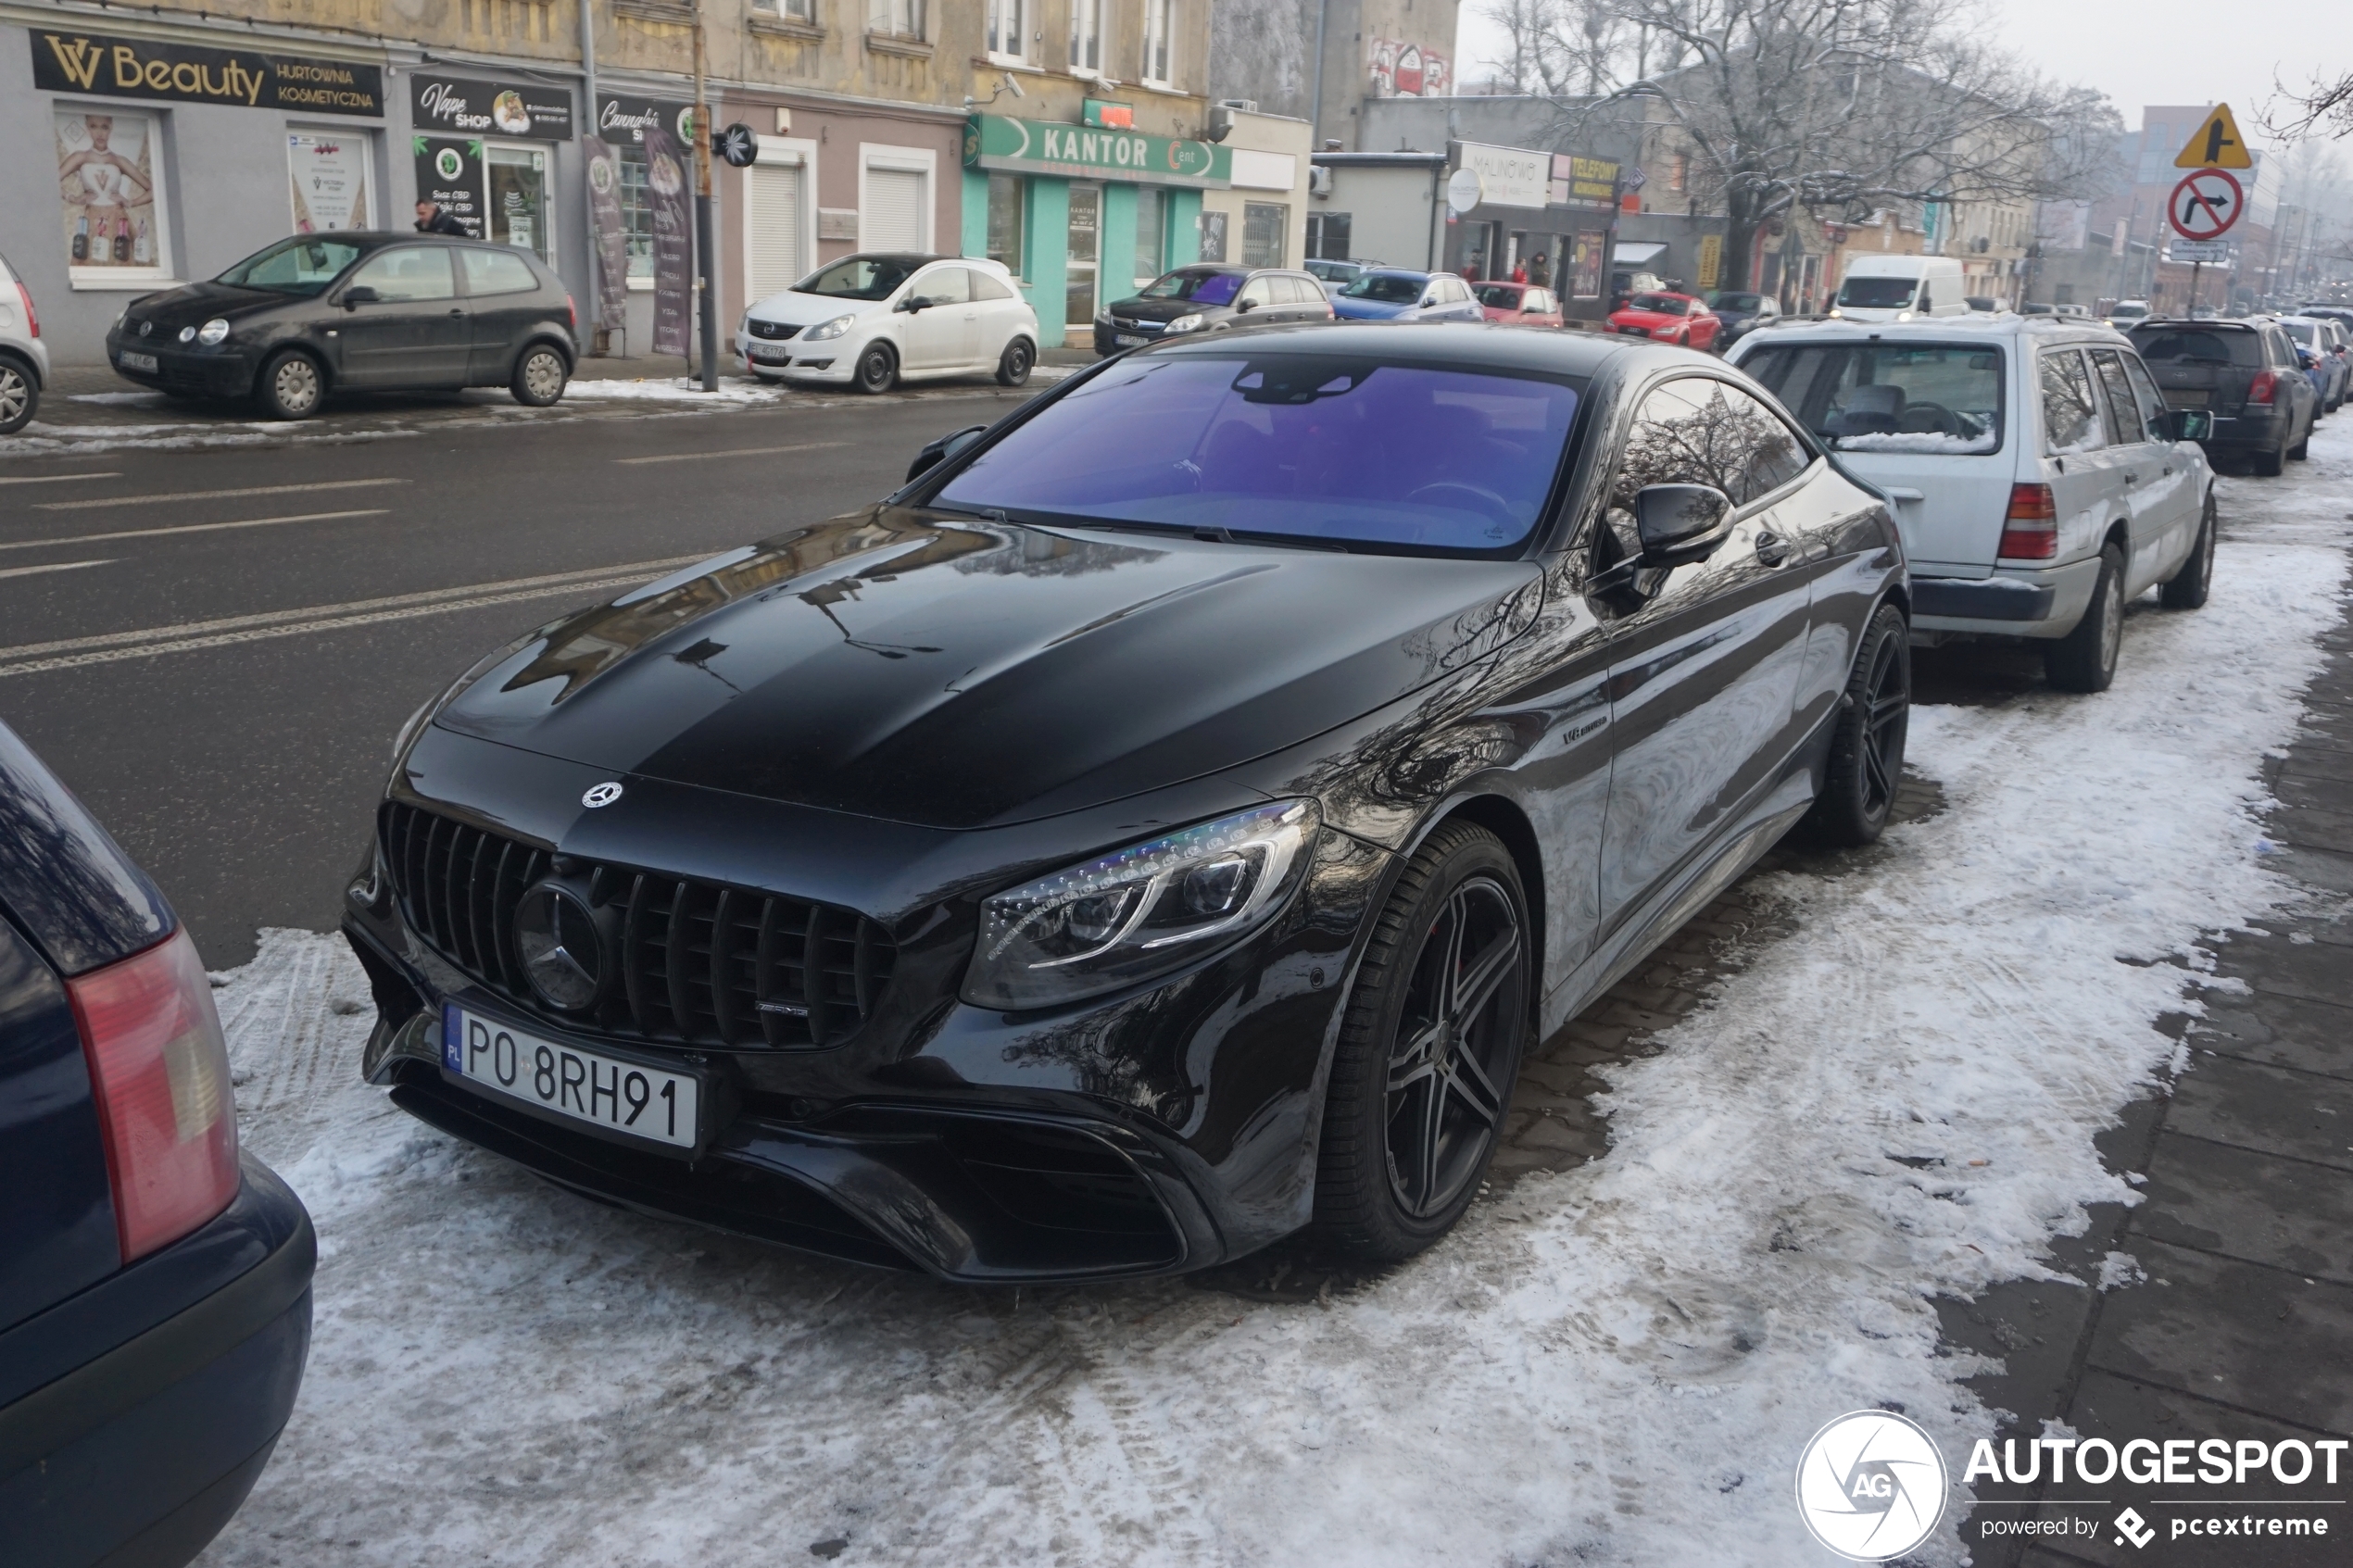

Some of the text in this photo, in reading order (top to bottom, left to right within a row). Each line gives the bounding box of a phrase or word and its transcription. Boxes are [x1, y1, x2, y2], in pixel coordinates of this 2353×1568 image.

[113, 45, 264, 106] Beauty
[277, 63, 354, 83] HURTOWNIA
[279, 86, 374, 107] KOSMETYCZNA
[421, 82, 467, 121] Vape
[455, 114, 492, 128] SHOP
[1044, 129, 1196, 169] KANTOR Cent
[1474, 156, 1537, 181] MALINOWO
[1572, 157, 1619, 181] TELEFONY
[432, 190, 471, 199] Susz CBD
[455, 203, 473, 211] CBD
[1118, 334, 1127, 343] PP
[751, 344, 783, 358] EL 4G176
[774, 1005, 809, 1017] AMG
[447, 1044, 460, 1062] PL
[469, 1019, 676, 1136] PO 8RH91
